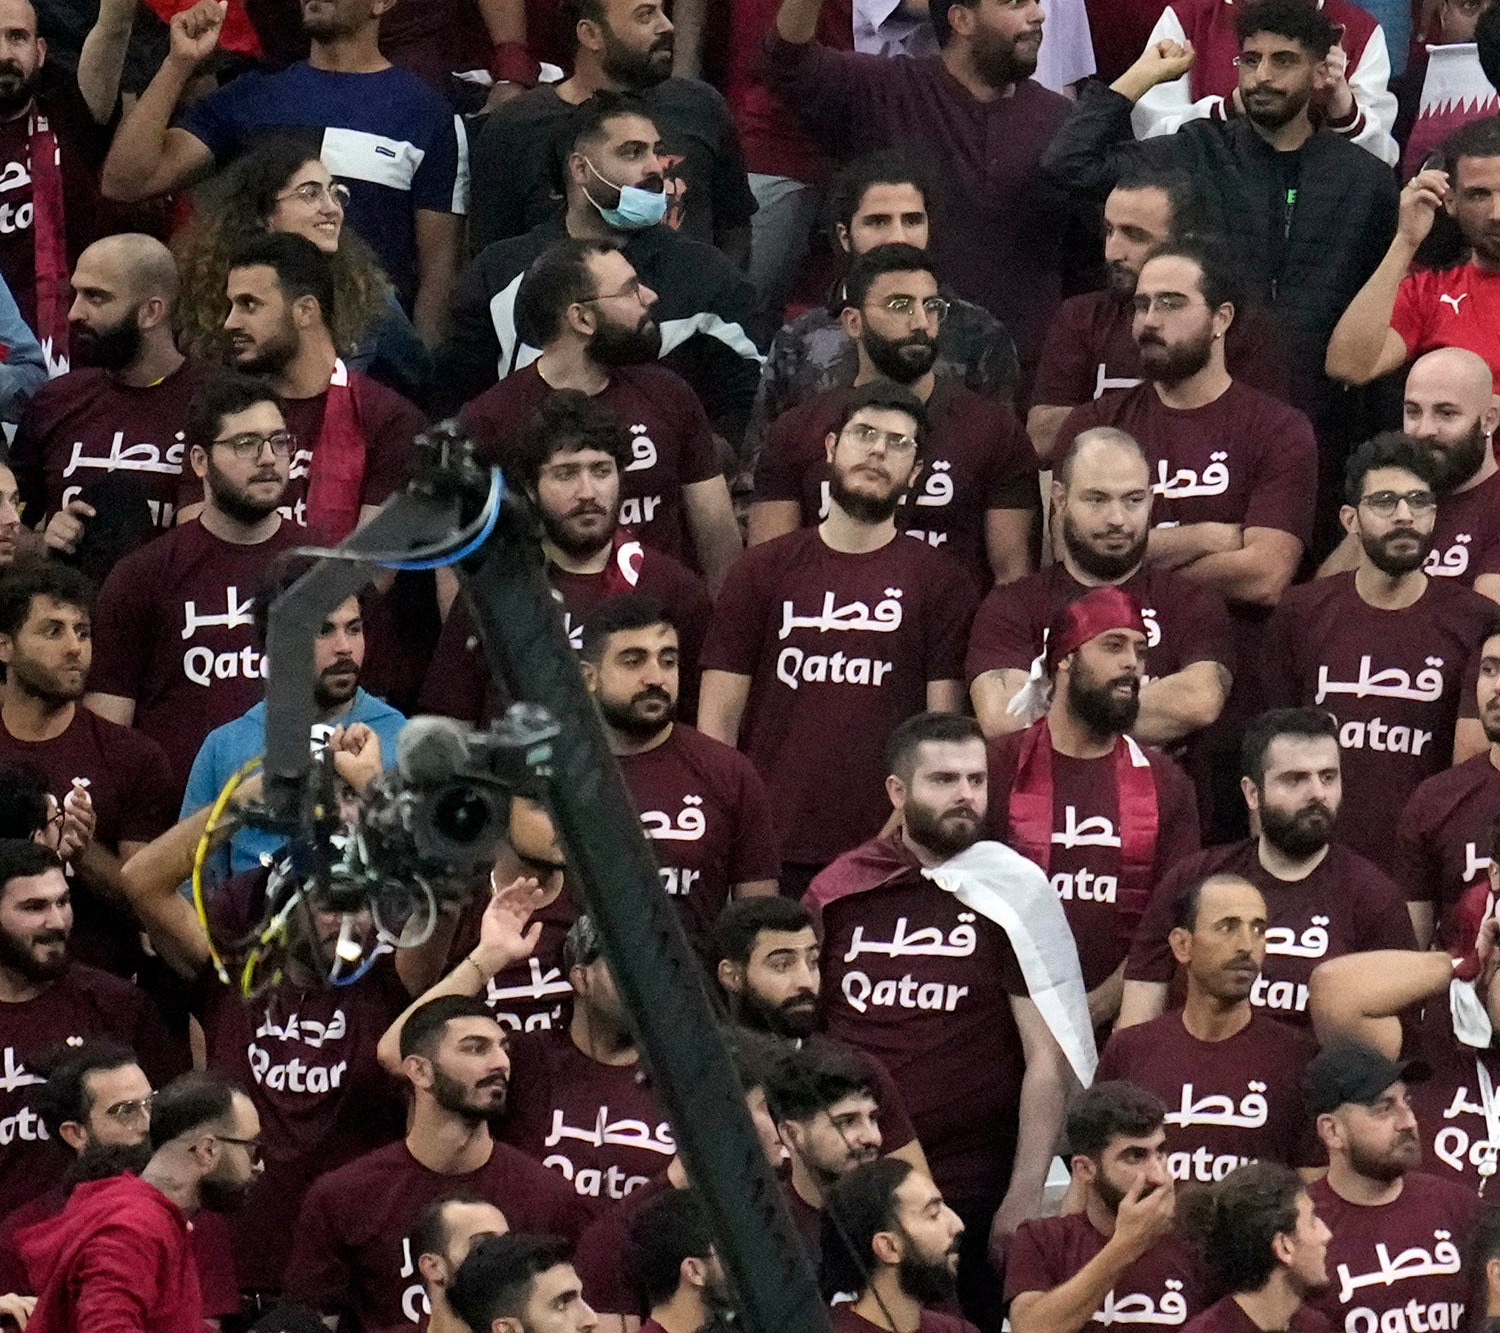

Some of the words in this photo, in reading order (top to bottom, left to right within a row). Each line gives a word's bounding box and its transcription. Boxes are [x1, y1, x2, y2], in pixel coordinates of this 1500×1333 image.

[1150, 452, 1229, 498] قط
[182, 587, 253, 639] طر
[779, 588, 902, 639] قطر
[184, 646, 269, 686] Qata
[777, 648, 892, 689] Qatar
[1315, 656, 1443, 704] قطر
[1339, 718, 1431, 755] atar
[1052, 868, 1117, 903] ata
[845, 913, 976, 962] قطر
[485, 958, 573, 1007] طر
[842, 971, 968, 1012] Qatar
[1250, 973, 1309, 1011] tar
[1164, 1081, 1267, 1127] قط
[543, 1155, 649, 1198] Qata
[1337, 1230, 1460, 1303] قطر
